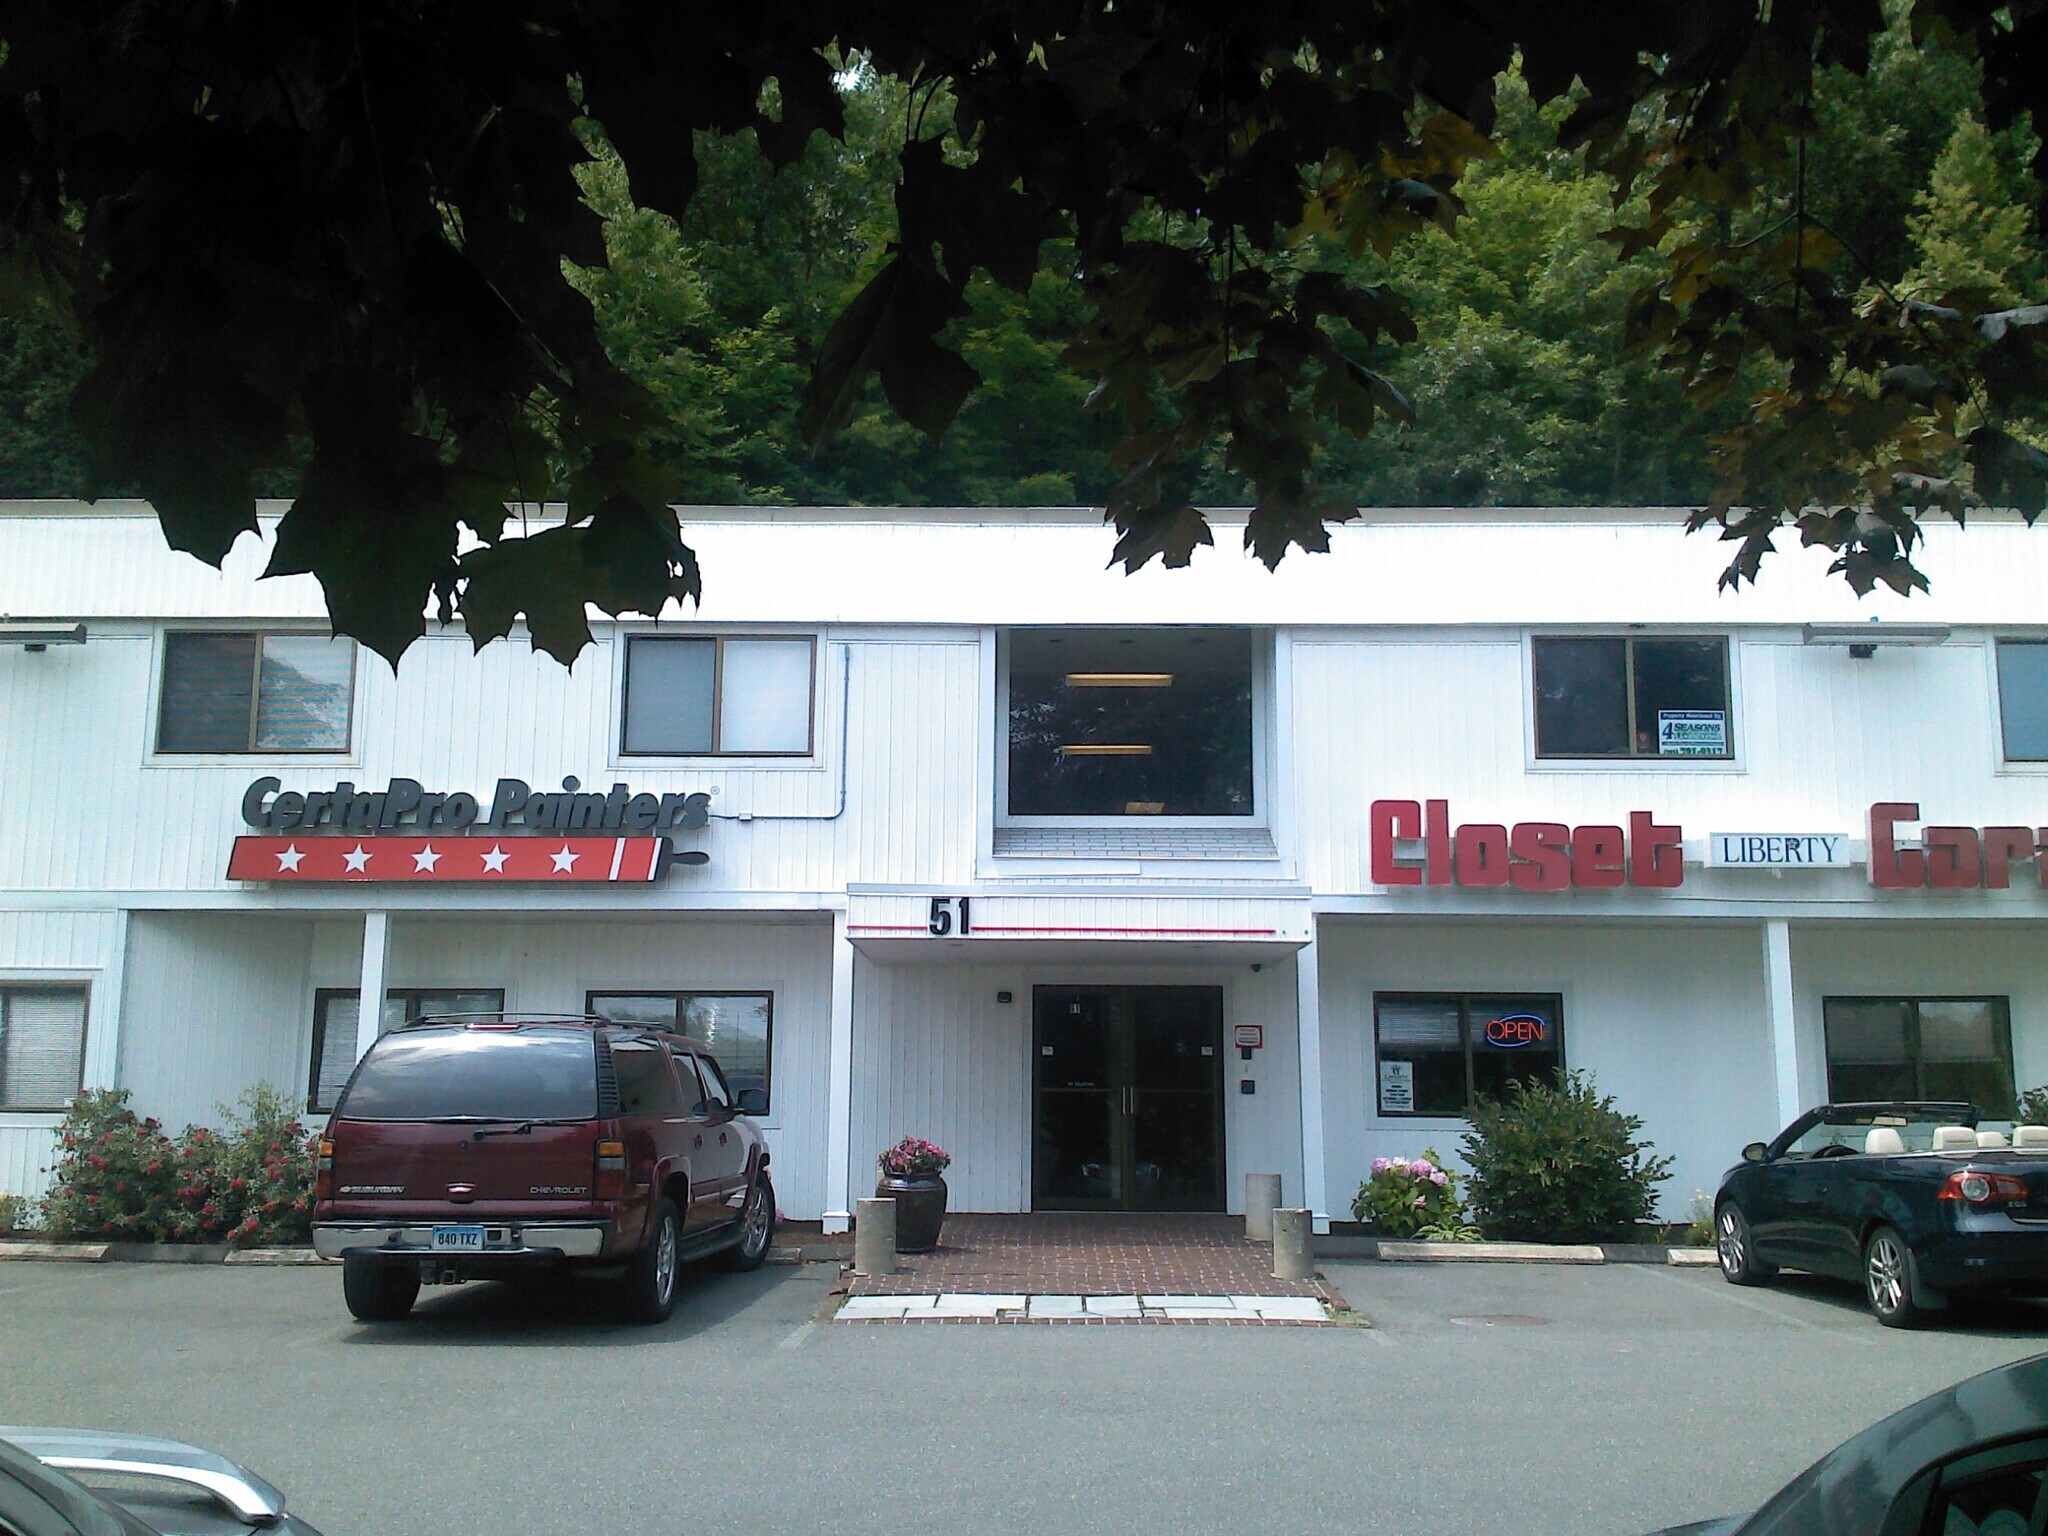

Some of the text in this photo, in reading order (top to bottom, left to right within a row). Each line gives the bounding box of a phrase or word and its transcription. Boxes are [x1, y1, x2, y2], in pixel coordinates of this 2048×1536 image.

[1662, 722, 1674, 739] 4
[1674, 723, 1721, 732] SEASONS
[241, 776, 479, 829] CertaPro
[1371, 799, 1684, 891] Closet
[1722, 836, 1839, 864] LIBERTY
[1867, 802, 2048, 889] Car
[929, 897, 969, 935] 51
[1487, 1020, 1543, 1040] OPEN
[530, 1186, 588, 1194] CHEVROLET
